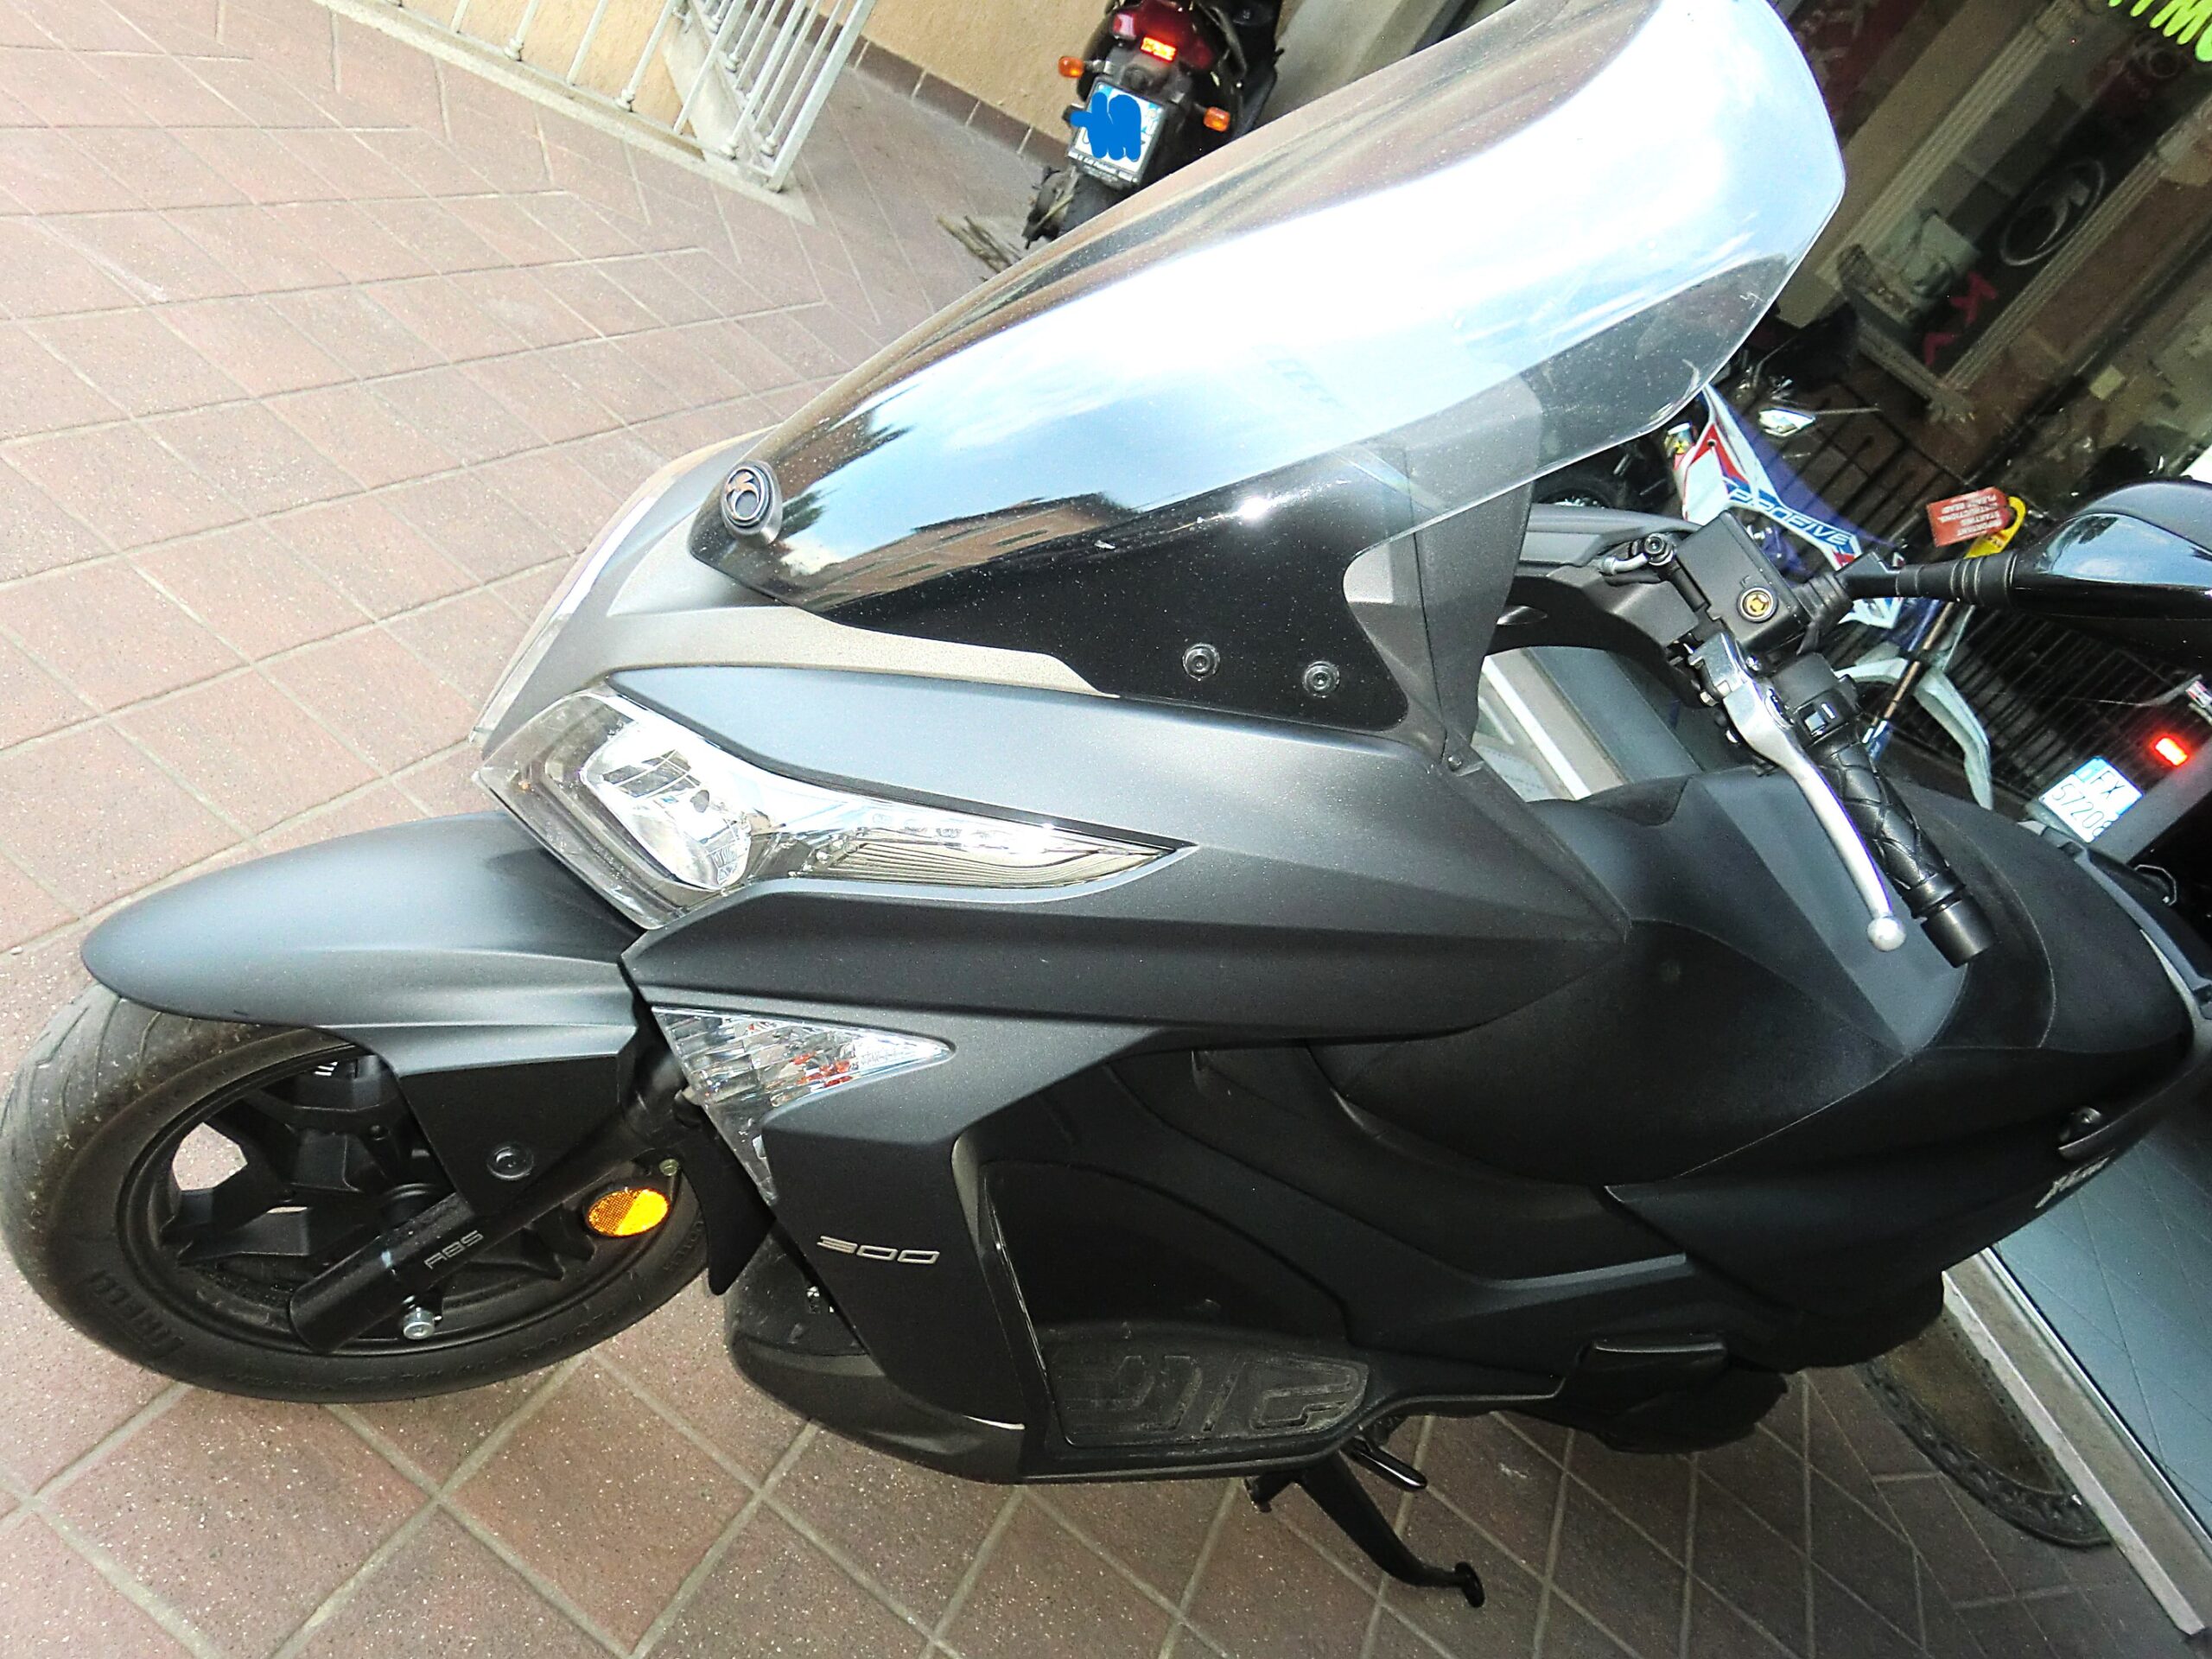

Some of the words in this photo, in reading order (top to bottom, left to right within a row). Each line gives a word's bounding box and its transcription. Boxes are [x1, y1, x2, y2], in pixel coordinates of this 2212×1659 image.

[2089, 769, 2126, 800] FX
[423, 1230, 485, 1270] ABS
[816, 1235, 941, 1264] 300
